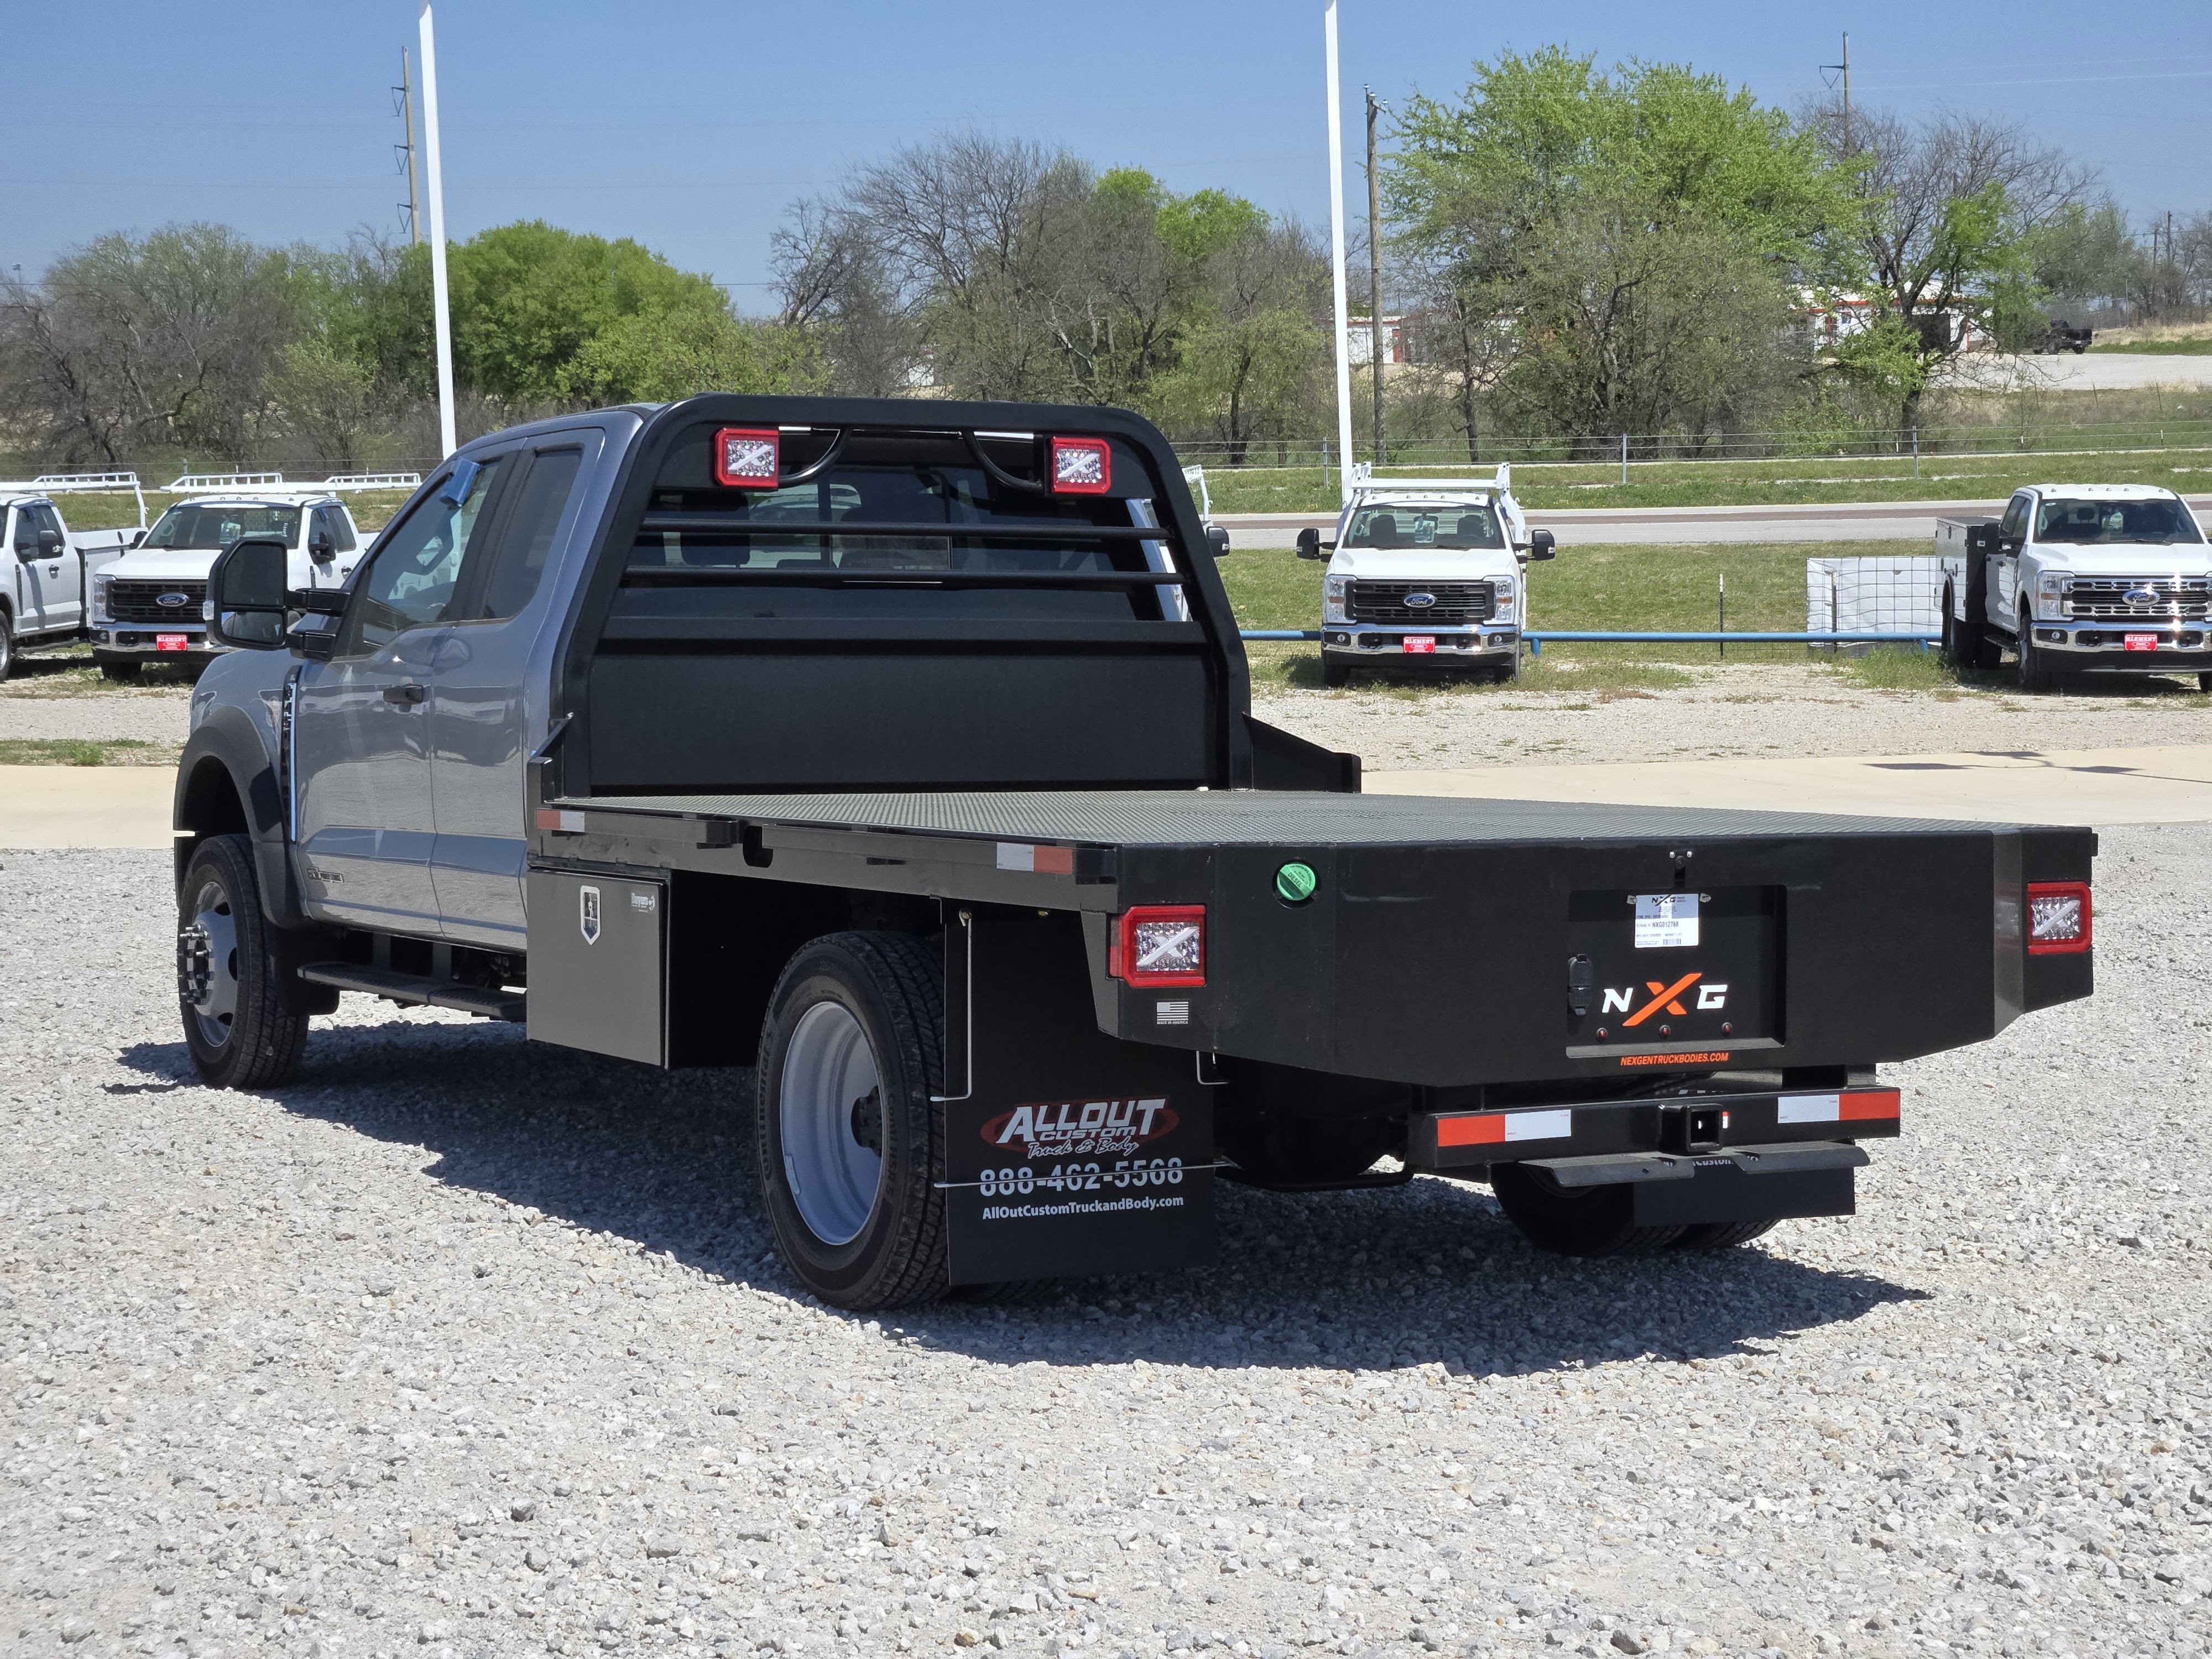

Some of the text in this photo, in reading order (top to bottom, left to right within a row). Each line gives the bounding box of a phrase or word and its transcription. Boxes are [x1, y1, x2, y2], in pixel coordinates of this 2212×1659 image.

[1287, 872, 1302, 888] DIESEL
[1651, 894, 1677, 906] NXG
[1601, 972, 1728, 1026] NXG
[1620, 1052, 1729, 1066] NEXGENTRUCKBODIES.COM
[995, 1098, 1166, 1144] ALLOUT
[1039, 1126, 1137, 1141] CUSTOM
[1027, 1138, 1073, 1159] Truck
[1095, 1135, 1140, 1156] Body
[979, 1157, 1183, 1197] 888-462-5568
[982, 1196, 1184, 1220] AllOutCustomTruckandBody.com
